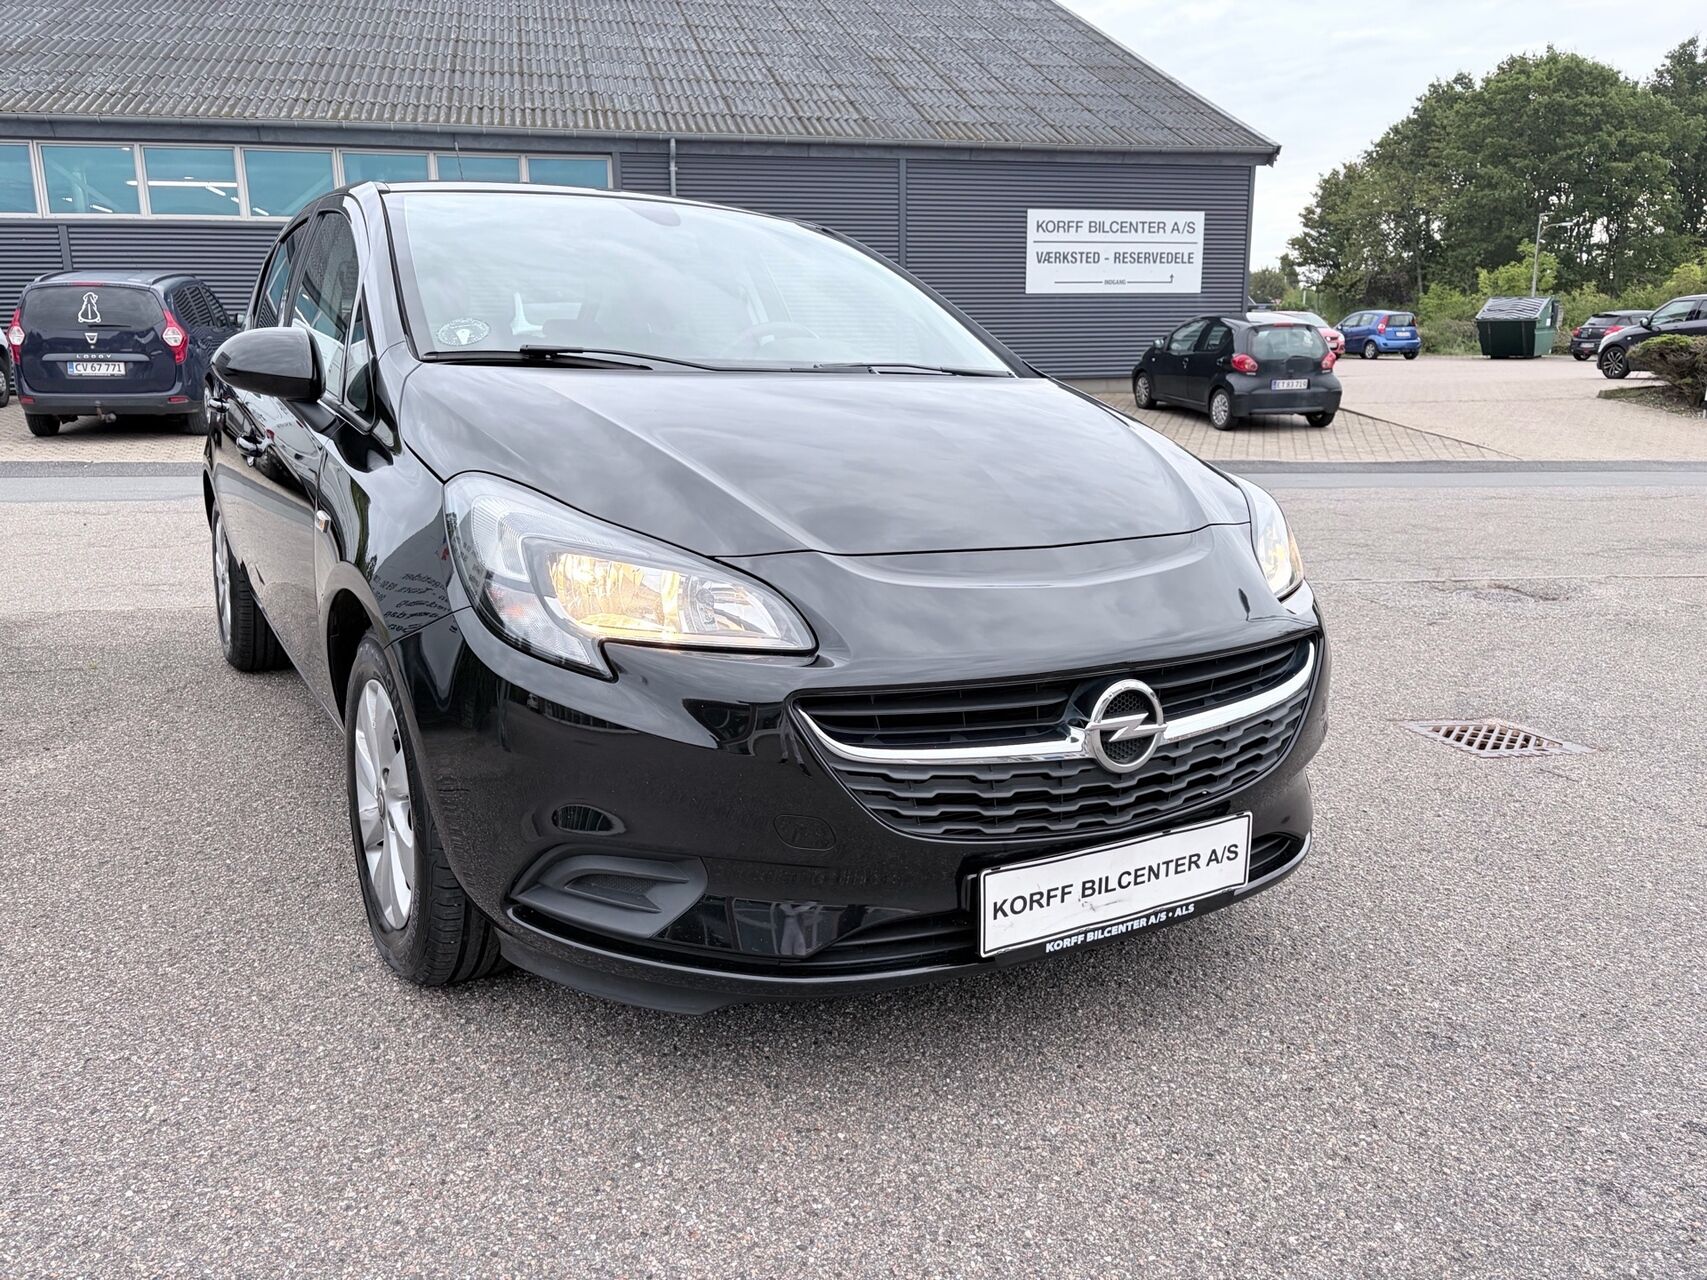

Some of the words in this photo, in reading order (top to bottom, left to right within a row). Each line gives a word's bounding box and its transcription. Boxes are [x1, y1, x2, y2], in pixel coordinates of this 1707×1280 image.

[1036, 220, 1084, 233] KORFF
[1088, 220, 1166, 234] BILCENTER
[1170, 221, 1196, 234] A/S
[1036, 251, 1100, 264] VÆRKSTED
[1114, 252, 1194, 264] RESERVEDELE
[75, 363, 88, 372] CV
[90, 363, 102, 372] 67
[104, 363, 122, 372] 771
[992, 884, 1074, 920] KORFF
[1081, 853, 1201, 899] BILCENTER
[1206, 844, 1239, 866] A/S
[1046, 933, 1085, 952] KORFF
[1086, 917, 1147, 942] BILCENTER
[1148, 911, 1167, 925] A/S
[1174, 904, 1195, 917] ALS
